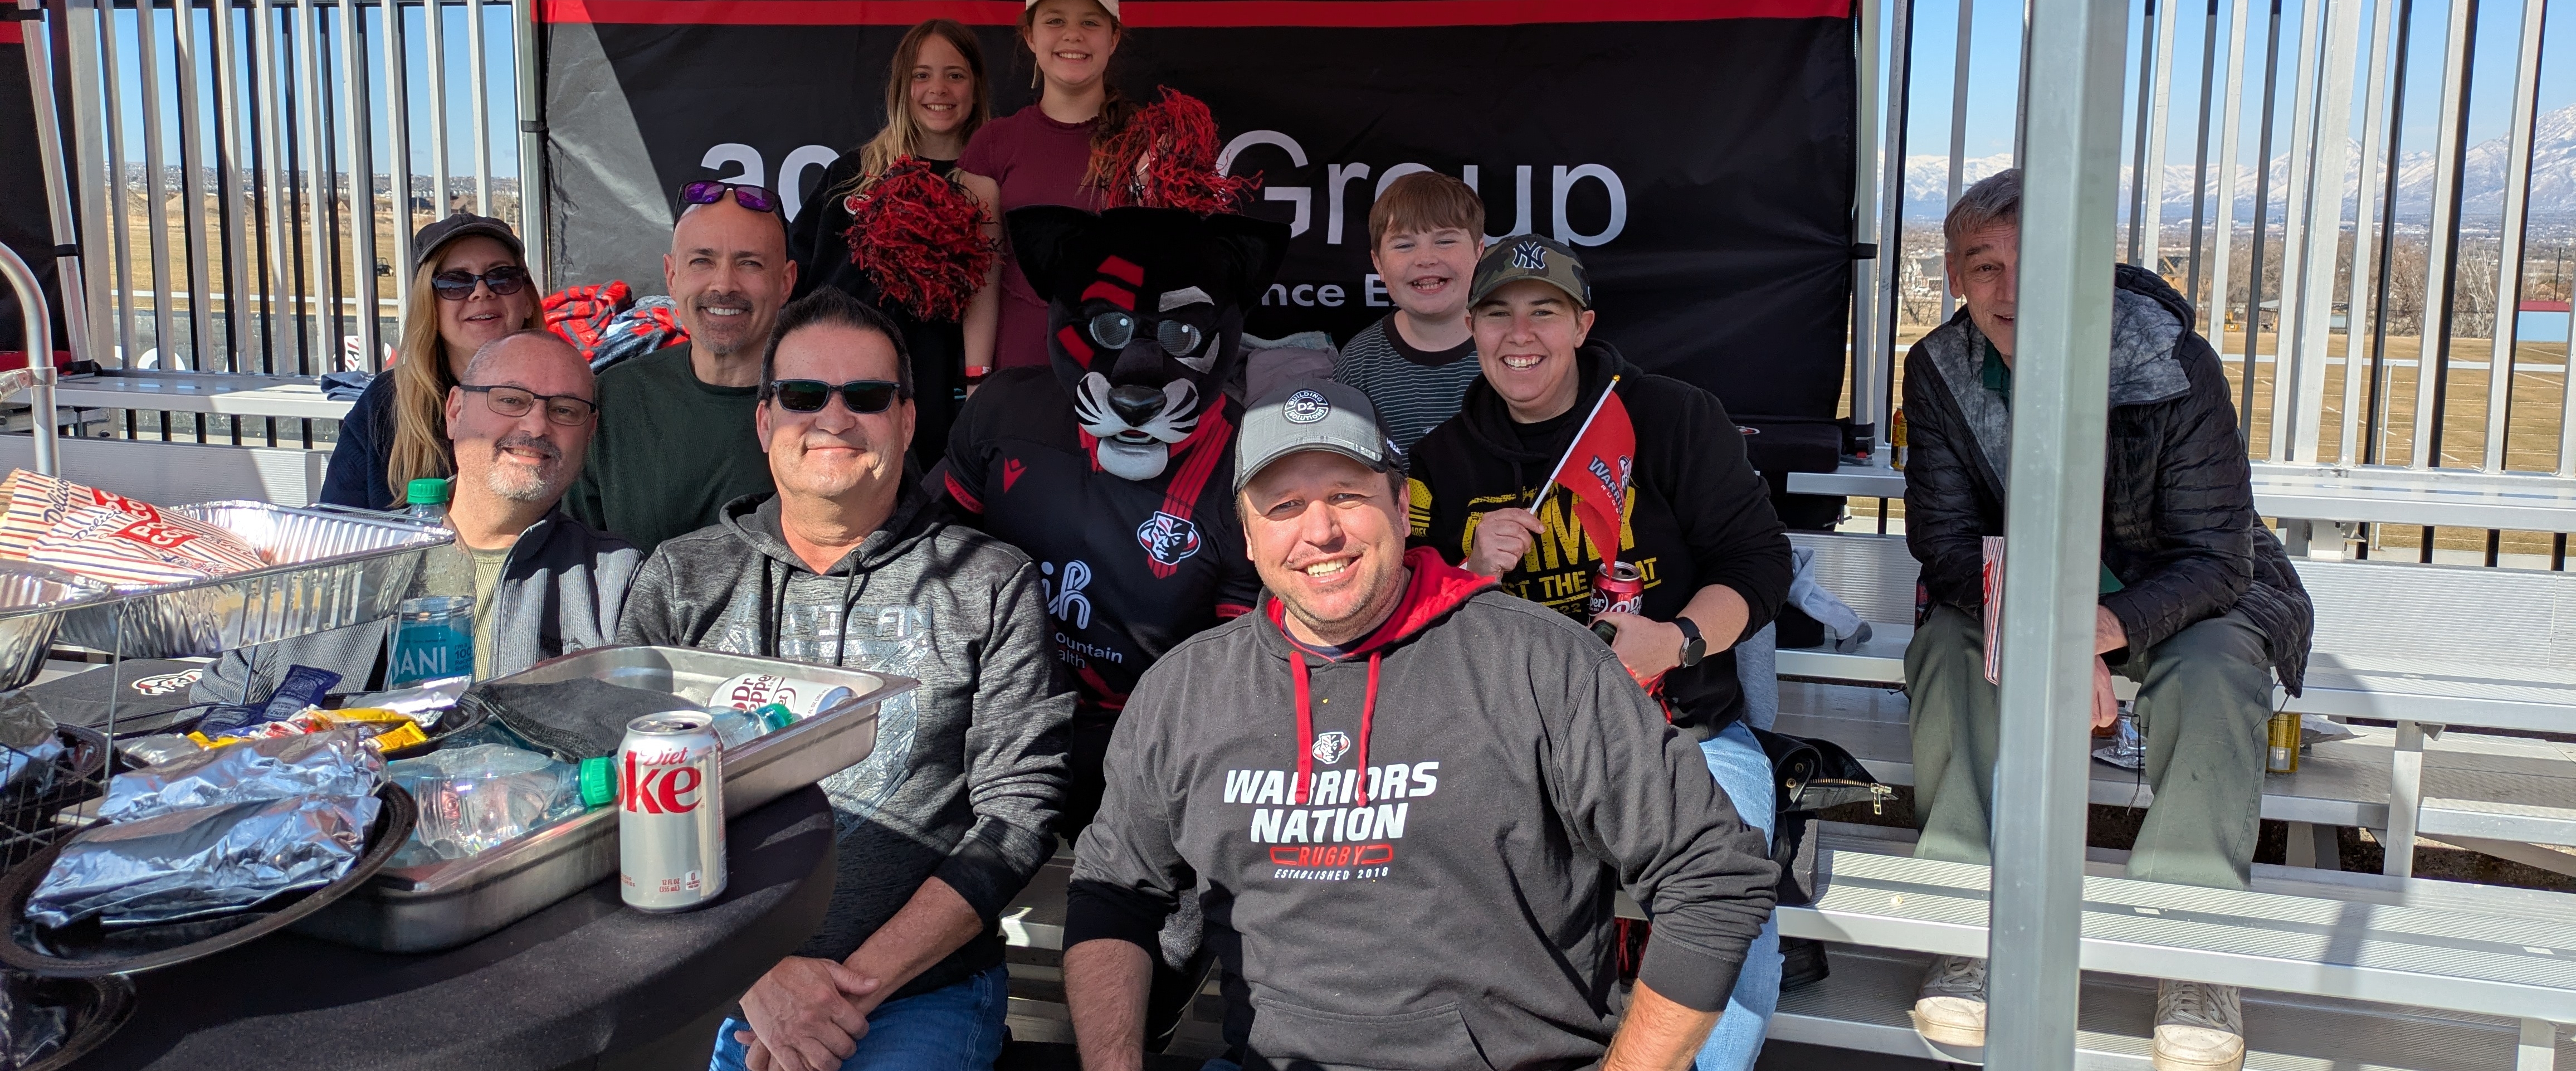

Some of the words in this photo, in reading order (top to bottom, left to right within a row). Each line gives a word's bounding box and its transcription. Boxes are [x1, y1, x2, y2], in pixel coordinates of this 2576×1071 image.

[1216, 129, 1627, 247] Grup
[1512, 241, 1546, 270] NY
[1288, 392, 1323, 405] BUILDING
[1297, 402, 1315, 411] D2
[1289, 408, 1325, 421] SOLUTIONS
[1539, 571, 1588, 598] THE
[1055, 632, 1123, 664] ountain
[1058, 649, 1086, 669] alth
[731, 678, 754, 702] Dr
[640, 746, 688, 766] Diet
[1250, 802, 1409, 844] NATION
[1298, 845, 1366, 866] RUGBY
[1274, 869, 1350, 880] ESTABLISHED
[1357, 866, 1388, 879] 2018
